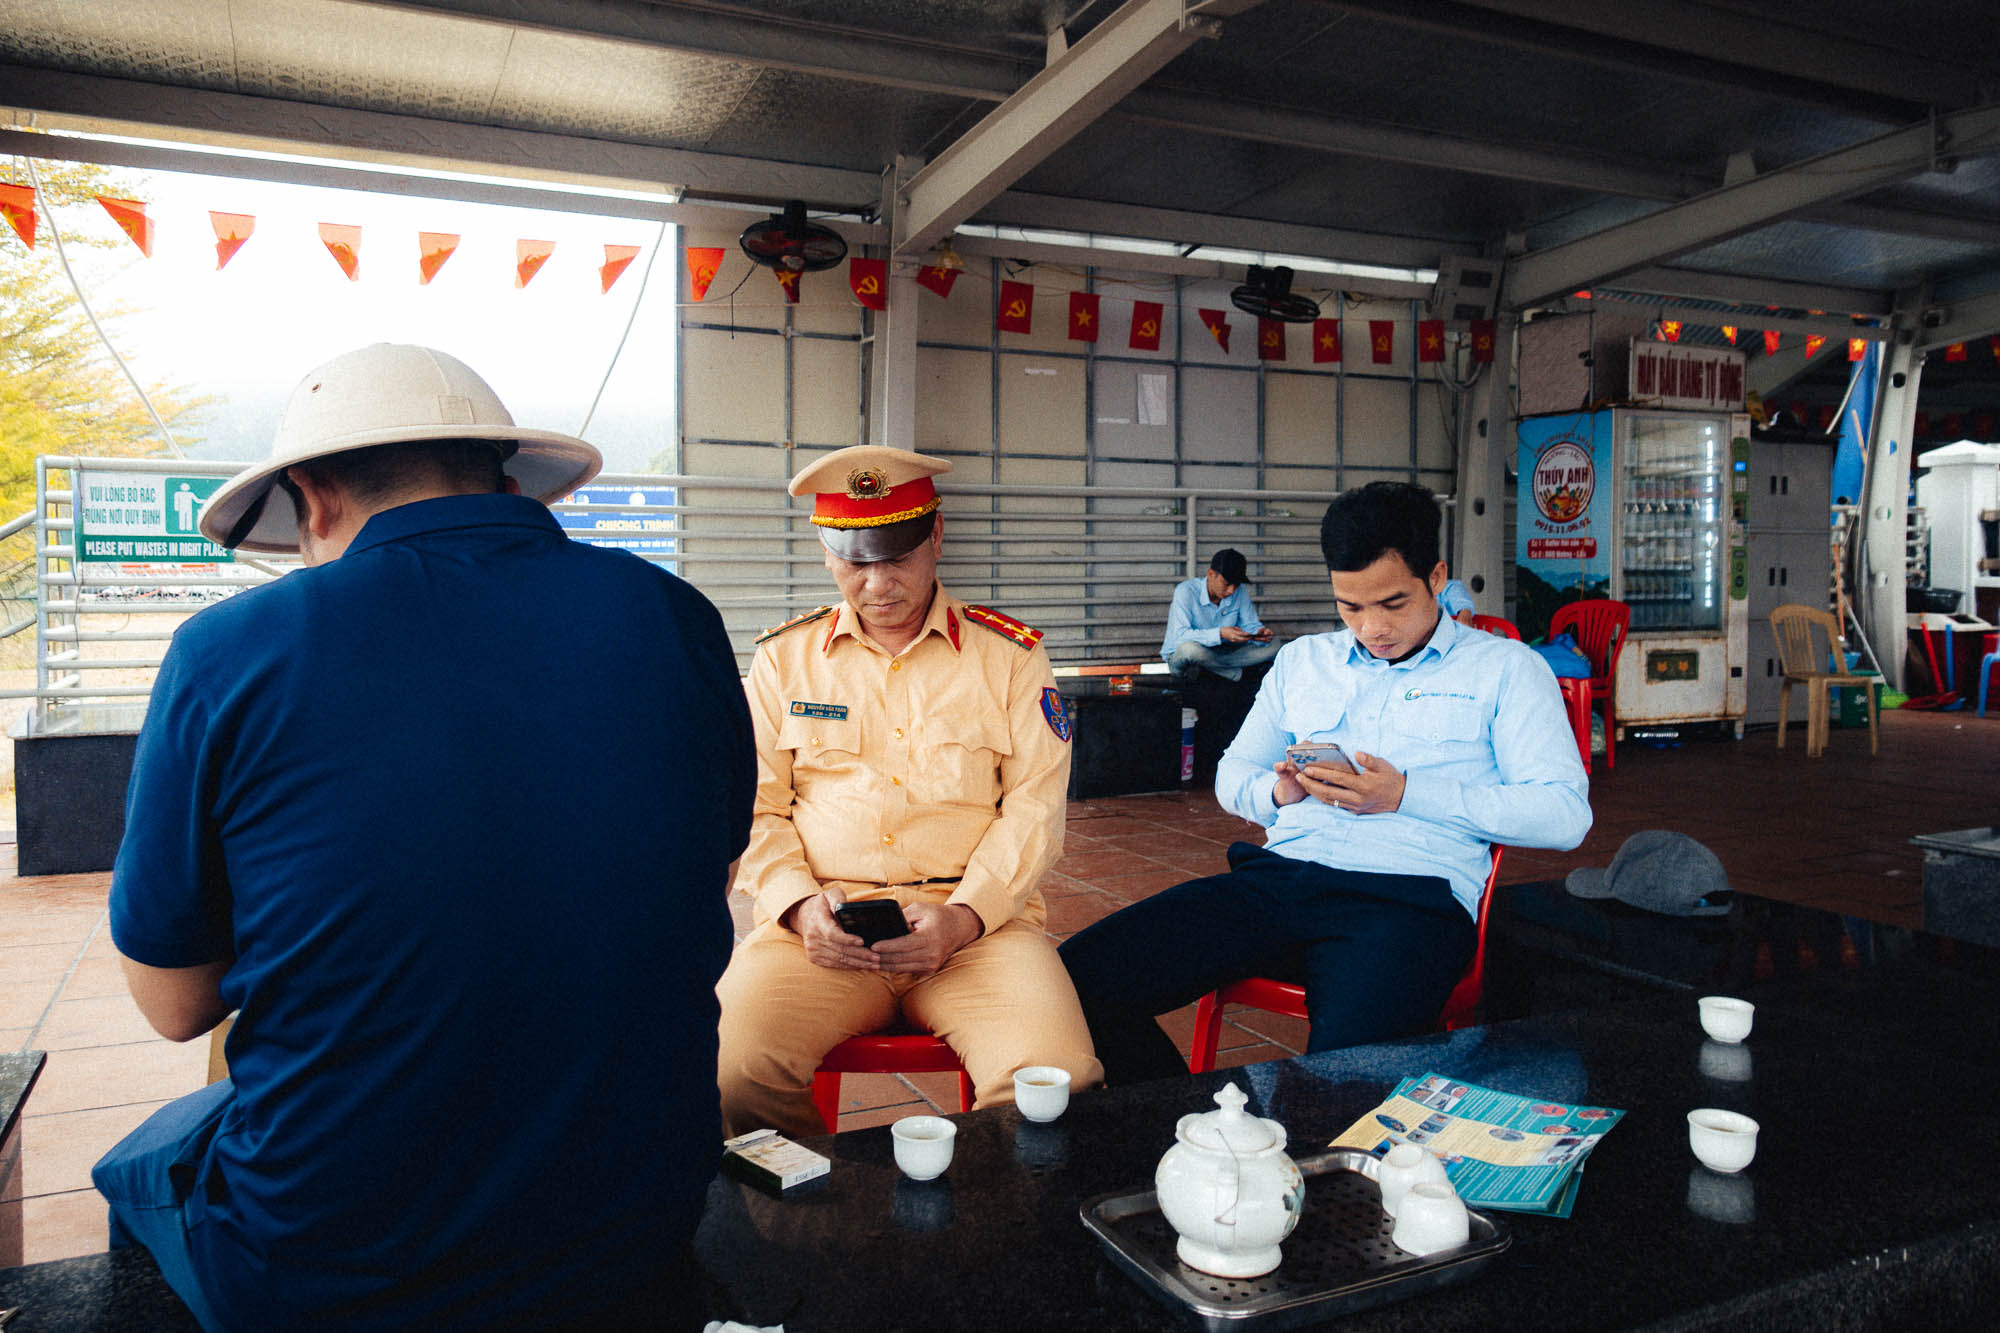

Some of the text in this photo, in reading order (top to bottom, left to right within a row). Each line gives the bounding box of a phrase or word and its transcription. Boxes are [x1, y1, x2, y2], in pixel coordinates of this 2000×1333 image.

[1567, 466, 1588, 484] ANH
[89, 486, 103, 502] VUI
[85, 541, 116, 556] PLEASE
[118, 541, 133, 556] PUT
[135, 542, 167, 557] WASTES
[169, 542, 177, 557] IN
[179, 542, 202, 557] RIGHT
